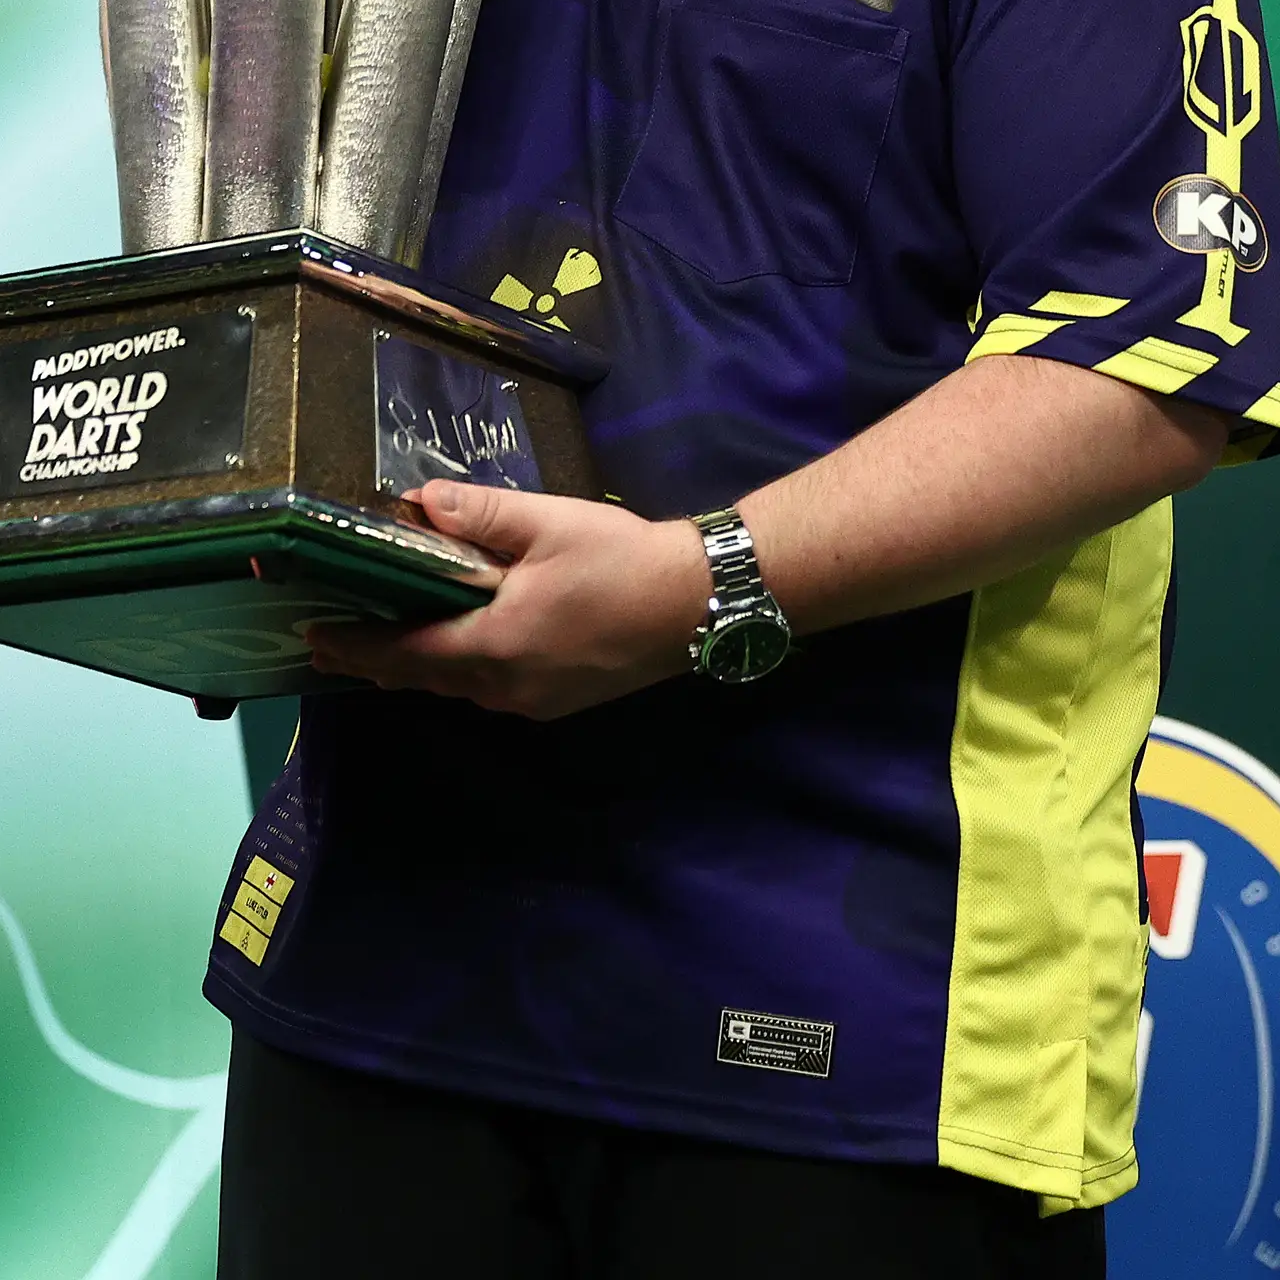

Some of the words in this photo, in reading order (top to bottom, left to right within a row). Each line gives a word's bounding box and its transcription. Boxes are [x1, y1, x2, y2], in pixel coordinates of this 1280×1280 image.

[1176, 191, 1258, 252] KP
[1217, 249, 1229, 299] TTLER
[31, 326, 187, 382] PADDYPOWER.
[32, 370, 168, 424] WORLD
[24, 411, 147, 464] DARTS
[19, 451, 139, 482] CHAMPIONSHIP
